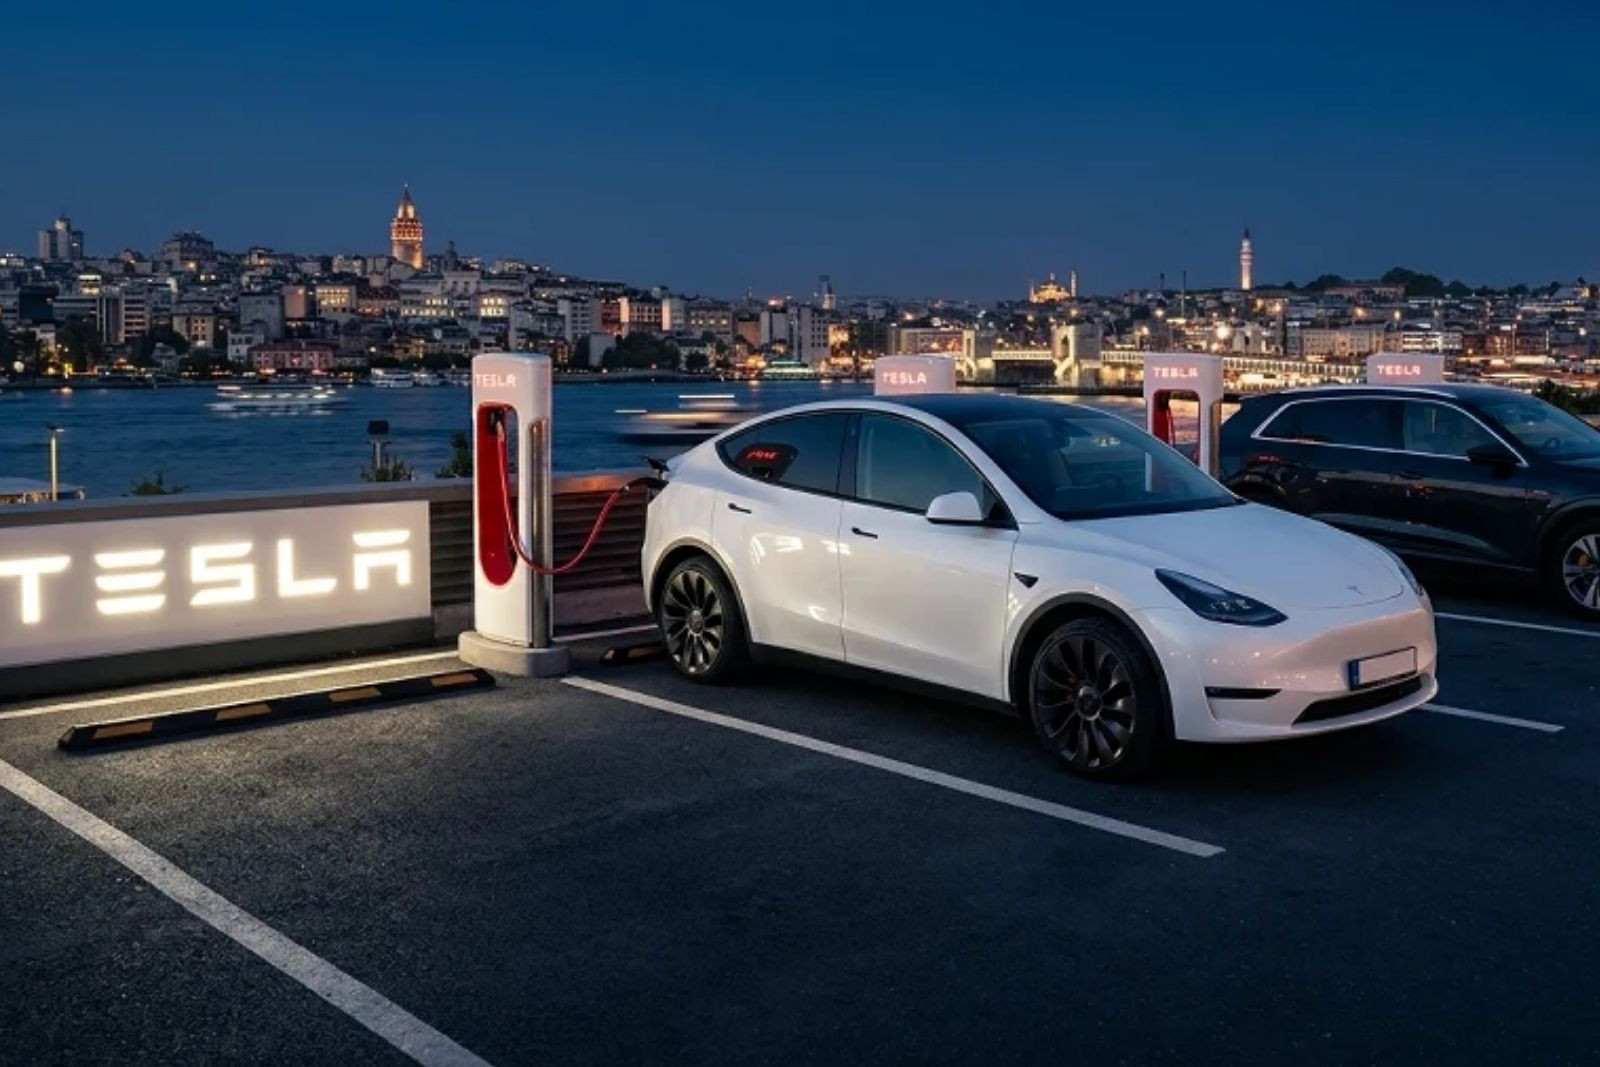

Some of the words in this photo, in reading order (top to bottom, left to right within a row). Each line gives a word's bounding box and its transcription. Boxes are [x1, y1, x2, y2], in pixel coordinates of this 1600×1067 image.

[883, 371, 927, 385] TESLA
[1153, 366, 1198, 379] TESLA
[475, 373, 516, 389] TESLA
[0, 529, 412, 624] TESLA
